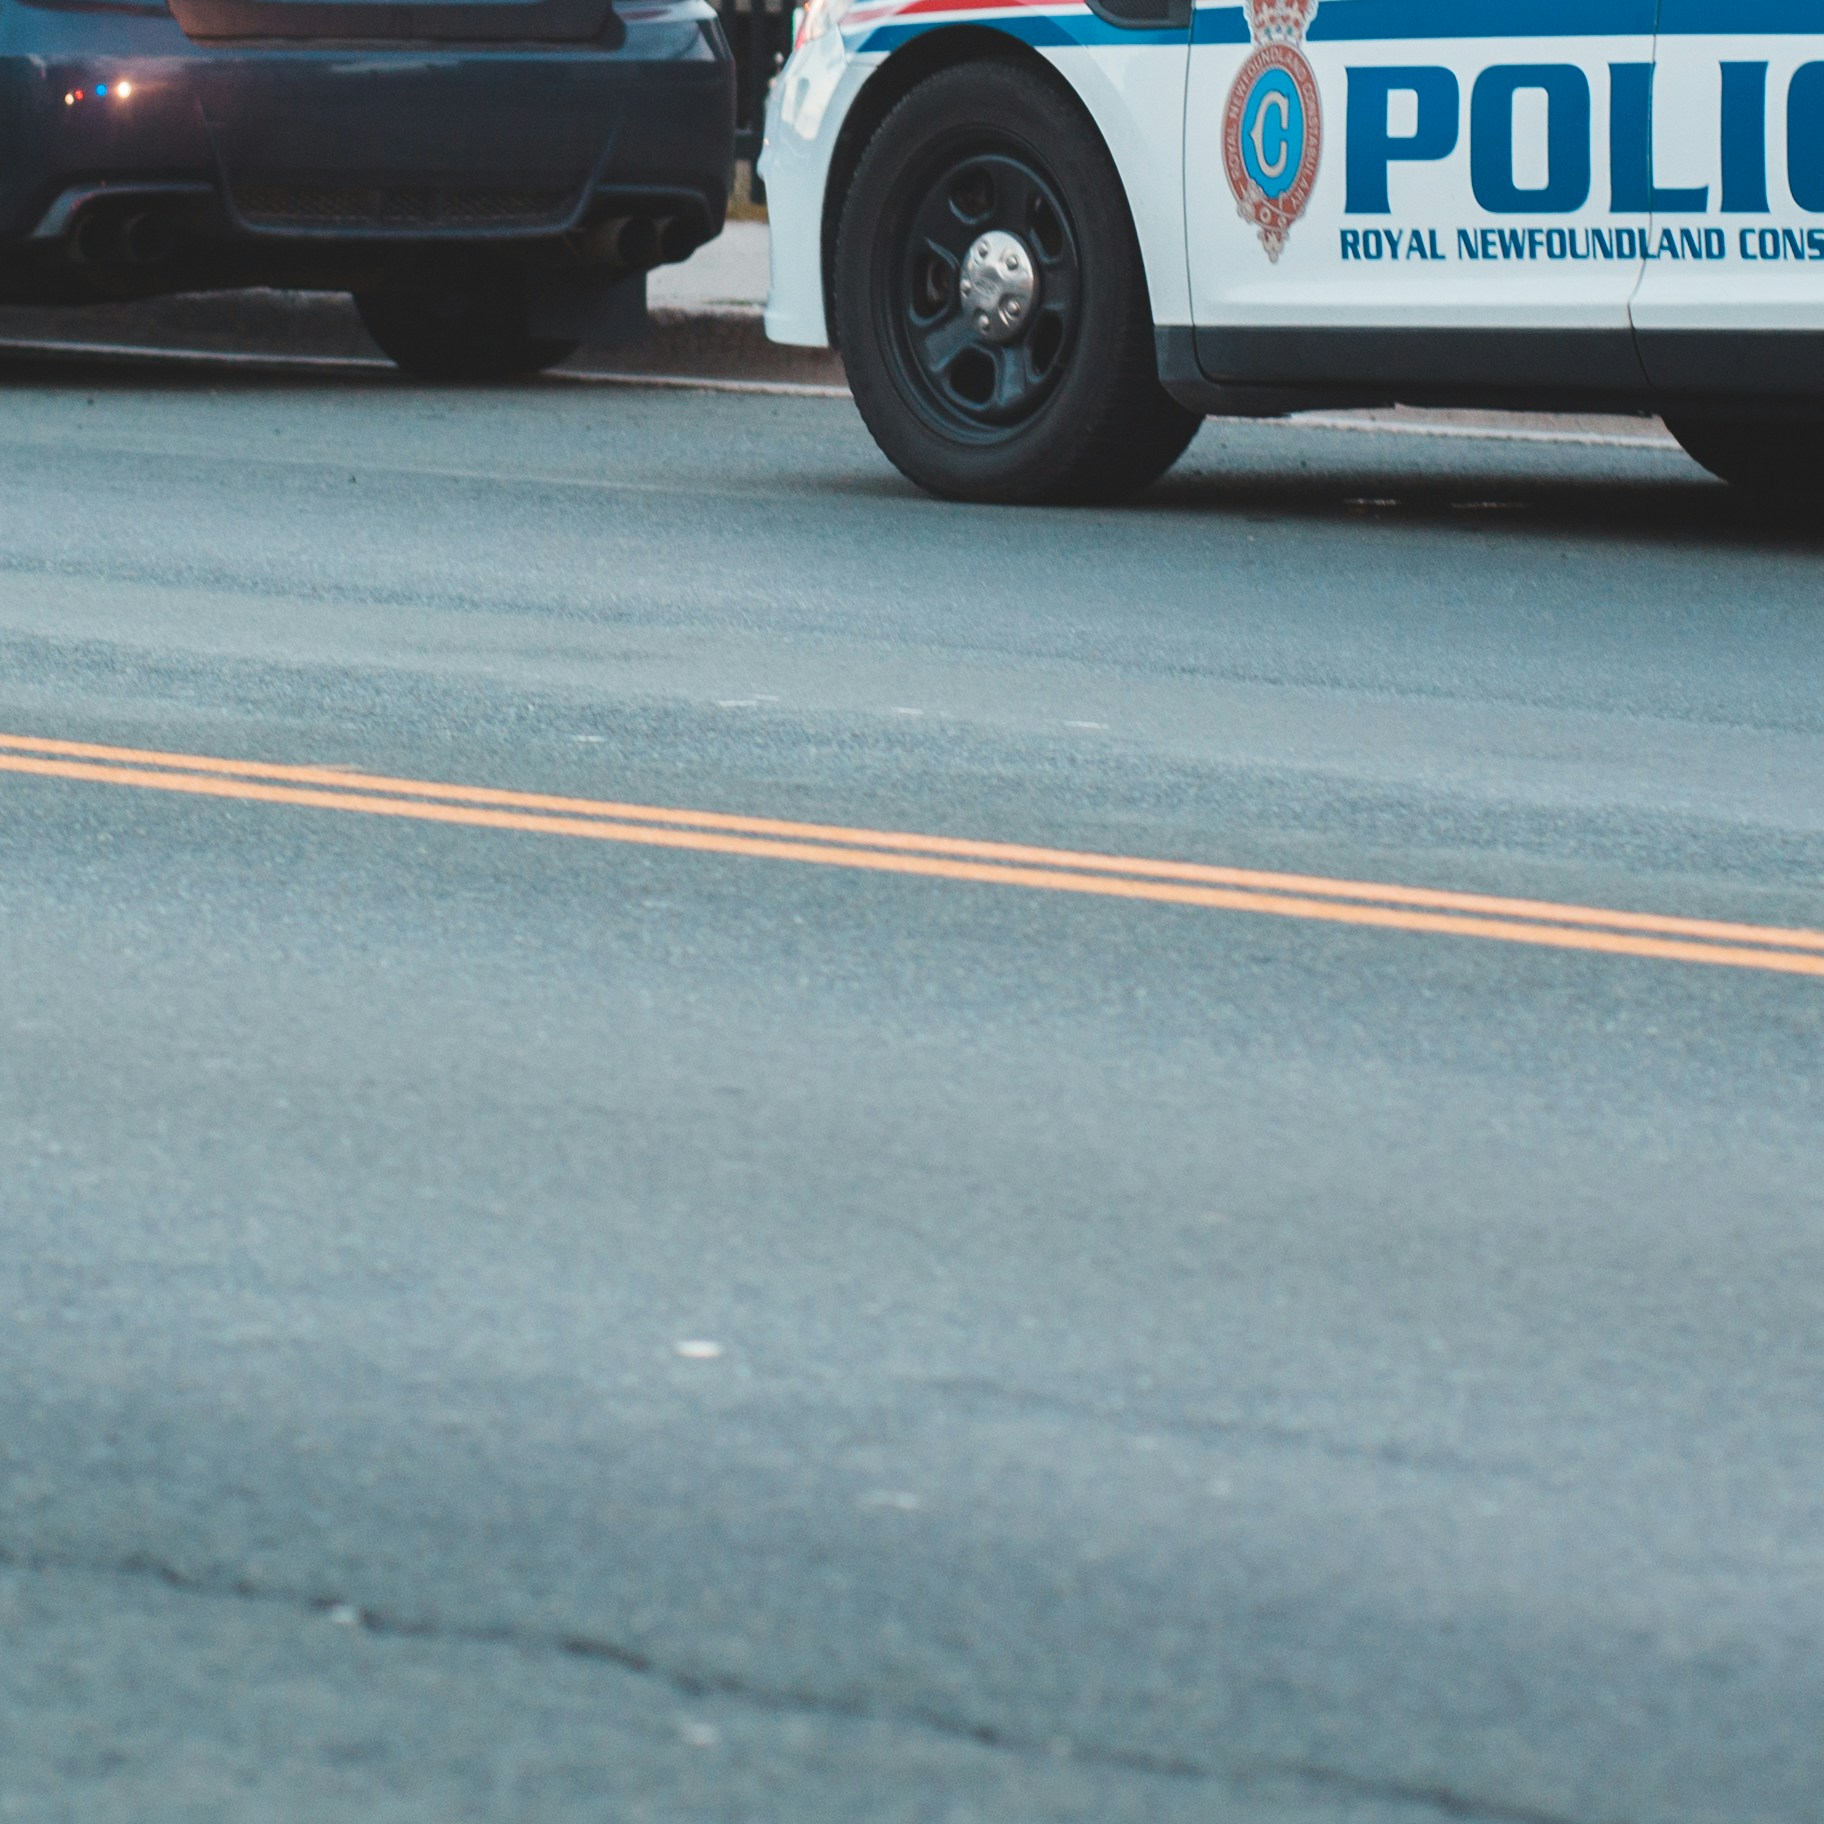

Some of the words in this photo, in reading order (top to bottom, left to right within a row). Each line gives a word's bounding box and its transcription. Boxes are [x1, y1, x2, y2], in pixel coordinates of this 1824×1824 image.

[1249, 90, 1289, 178] C
[1340, 227, 1446, 262] ROYAL
[1457, 227, 1726, 262] NEWFOUNDLAND
